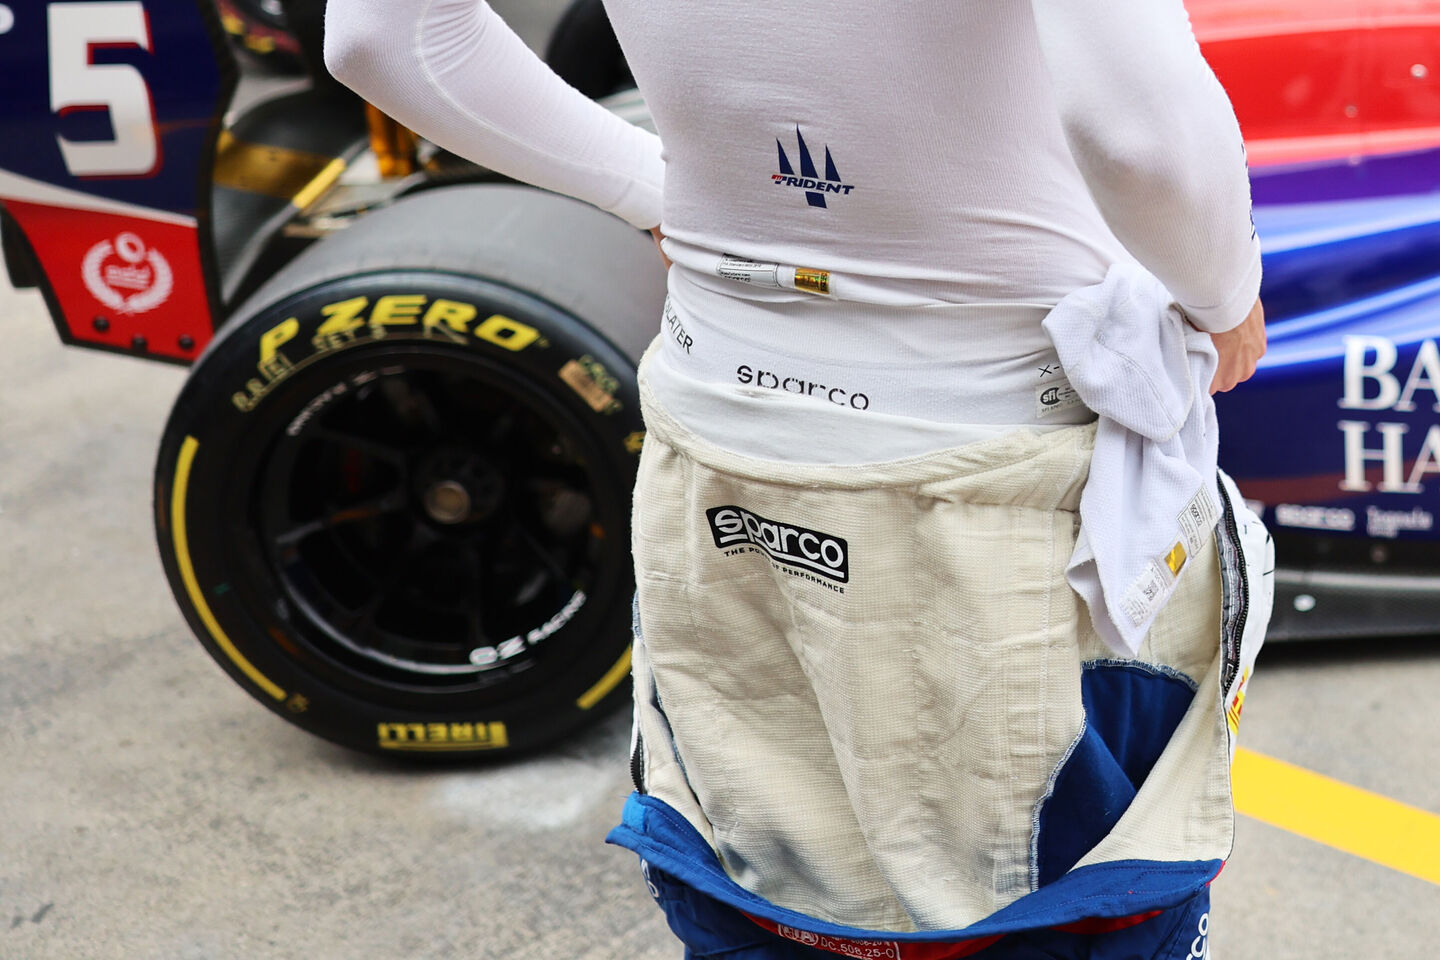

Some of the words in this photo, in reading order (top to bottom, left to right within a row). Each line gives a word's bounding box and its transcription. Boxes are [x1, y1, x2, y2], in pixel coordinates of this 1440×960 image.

[47, 1, 164, 180] 5
[771, 174, 855, 195] TRIDENT
[257, 317, 300, 365] P
[317, 295, 540, 352] ZERO
[736, 365, 869, 411] sparco
[714, 509, 845, 579] sparco
[724, 547, 745, 557] THE
[782, 567, 845, 594] PERFORMANCE
[377, 722, 507, 751] PIRELLI
